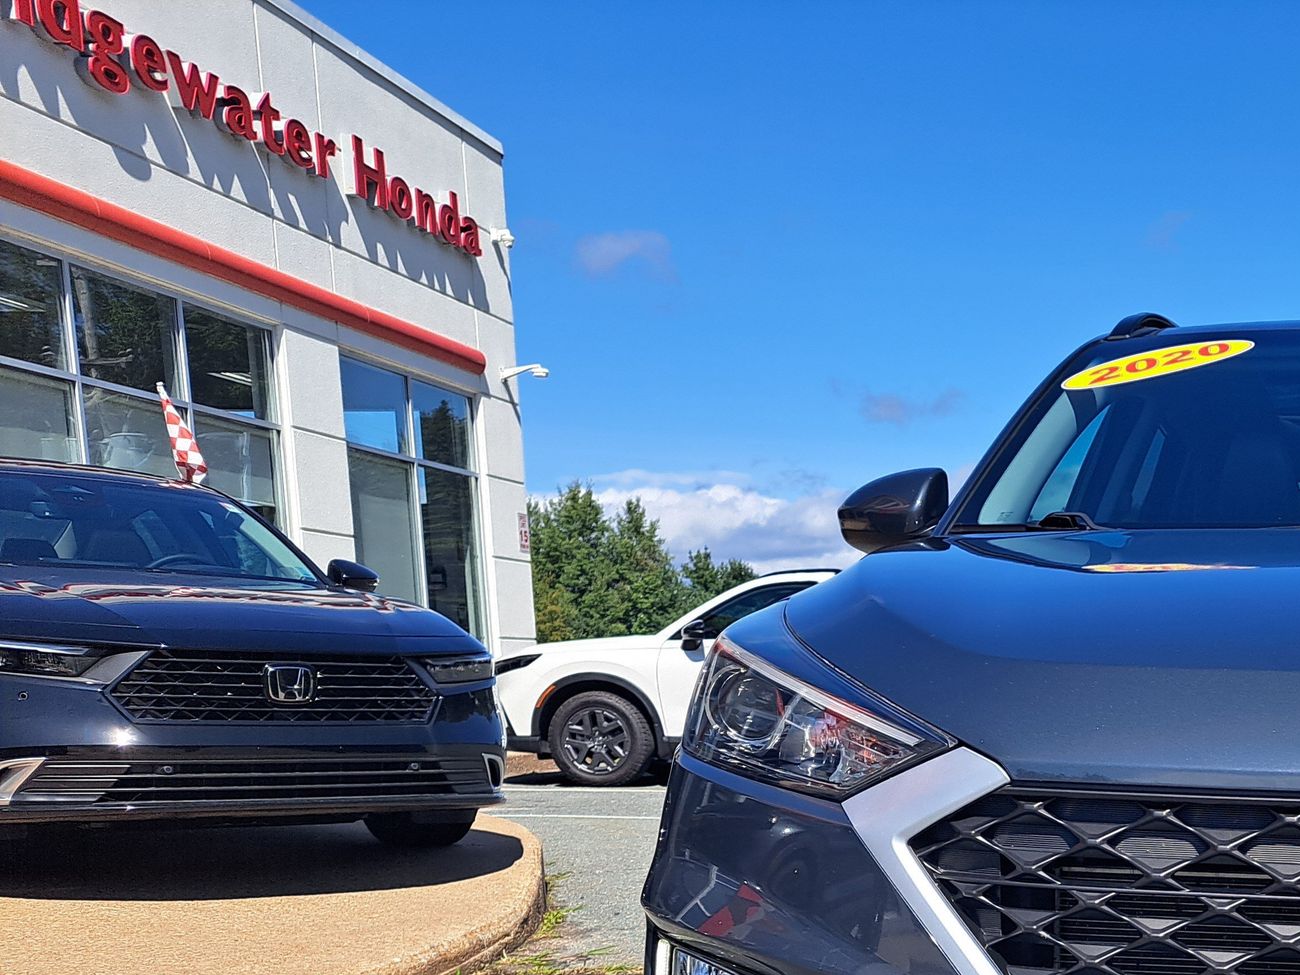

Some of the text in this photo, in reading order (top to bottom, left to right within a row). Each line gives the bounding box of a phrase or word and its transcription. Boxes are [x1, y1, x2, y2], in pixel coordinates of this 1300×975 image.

[14, 0, 482, 257] dgewater Honda
[1088, 342, 1231, 386] 2020
